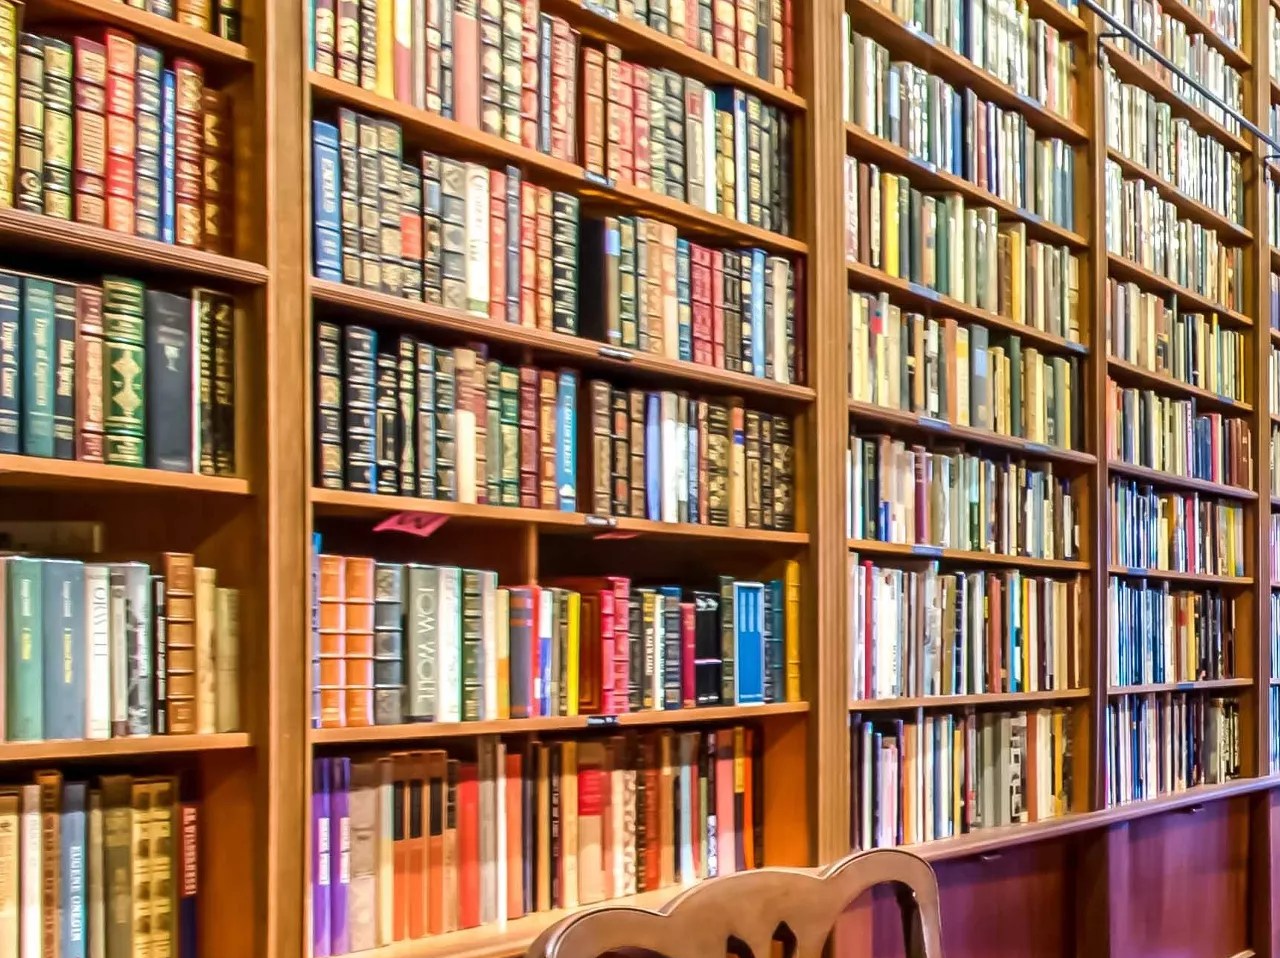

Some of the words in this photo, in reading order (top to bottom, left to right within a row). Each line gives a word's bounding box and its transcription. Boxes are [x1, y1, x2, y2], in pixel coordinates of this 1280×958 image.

[1, 322, 17, 350] Tropic
[33, 318, 48, 345] Tropic
[3, 354, 17, 363] of
[36, 349, 48, 359] of
[59, 339, 75, 365] Black
[2, 368, 17, 399] Cancer
[33, 362, 48, 406] Capricorn
[56, 366, 75, 396] Spring
[92, 587, 106, 658] ORWELL
[416, 587, 435, 634] TOM
[70, 846, 82, 893] EUGENE
[70, 895, 81, 941] ONEGIN
